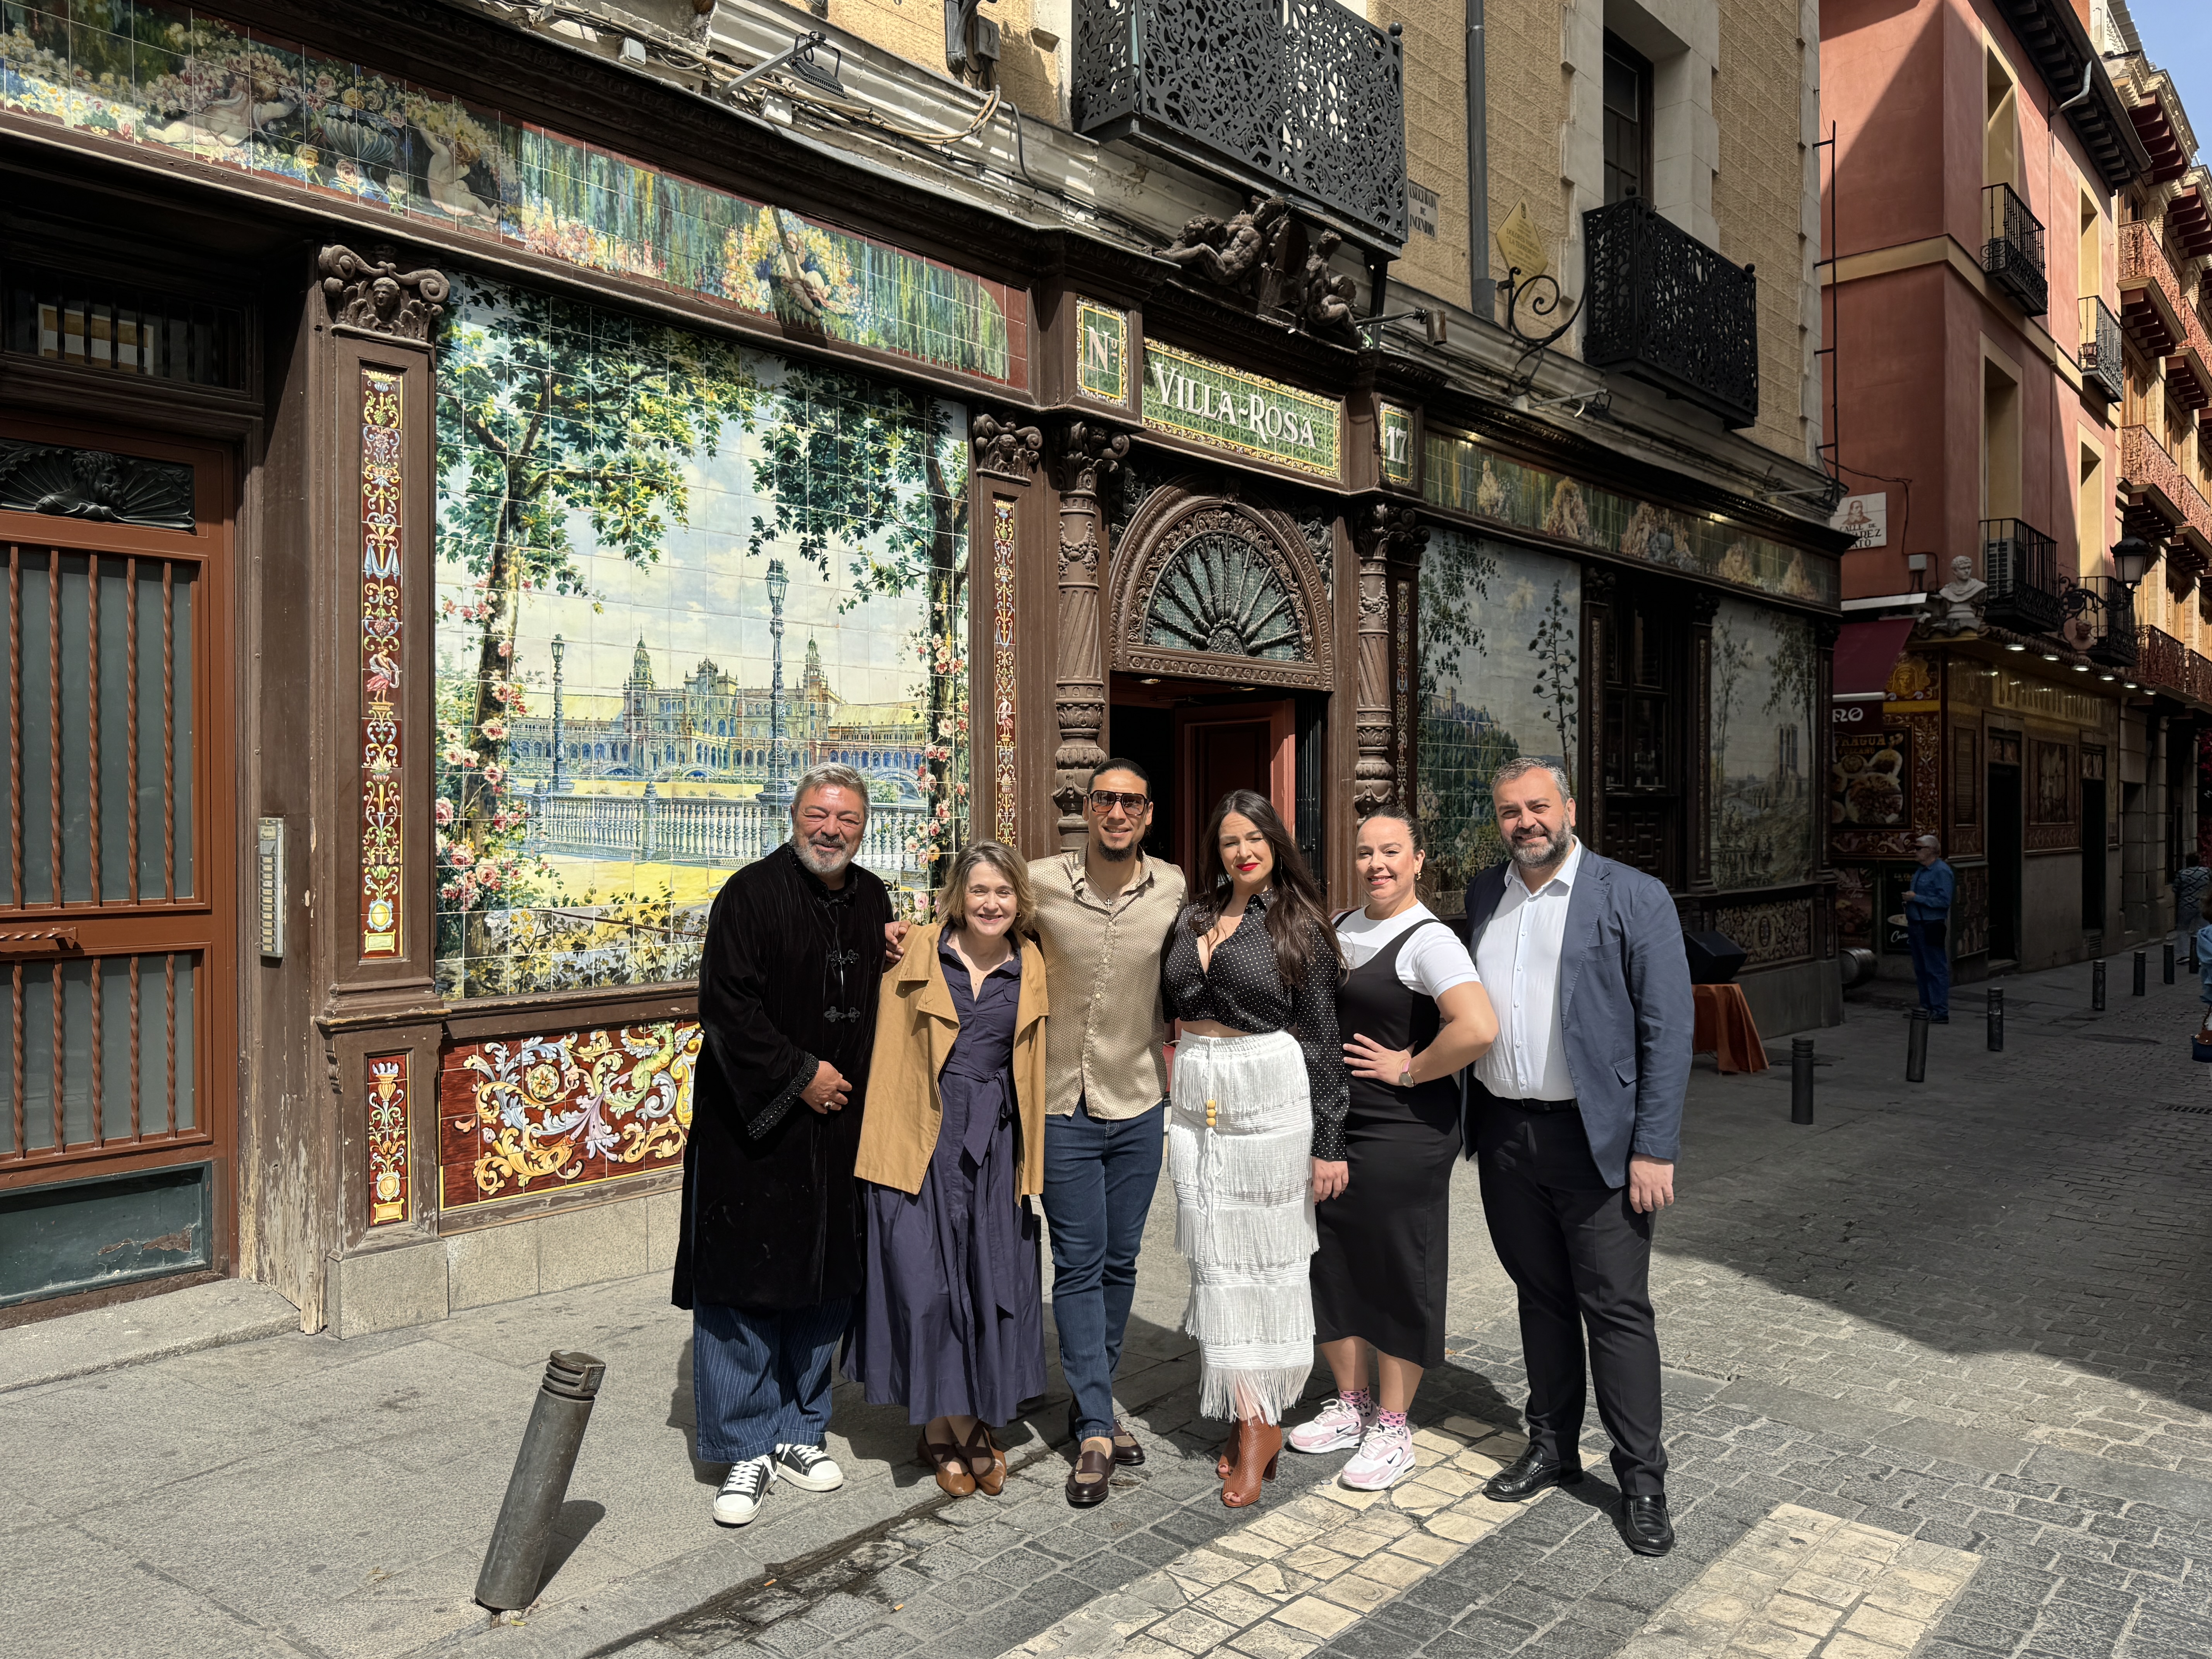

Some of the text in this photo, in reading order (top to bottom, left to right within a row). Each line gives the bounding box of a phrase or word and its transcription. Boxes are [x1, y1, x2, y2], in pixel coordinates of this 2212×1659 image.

[1408, 184, 1436, 210] ASEGURADA
[1420, 206, 1426, 216] DE
[1410, 214, 1435, 237] INCENDIOS
[1386, 426, 1407, 464] 17
[1852, 529, 1882, 539] AREZ
[1852, 539, 1872, 548] ATO
